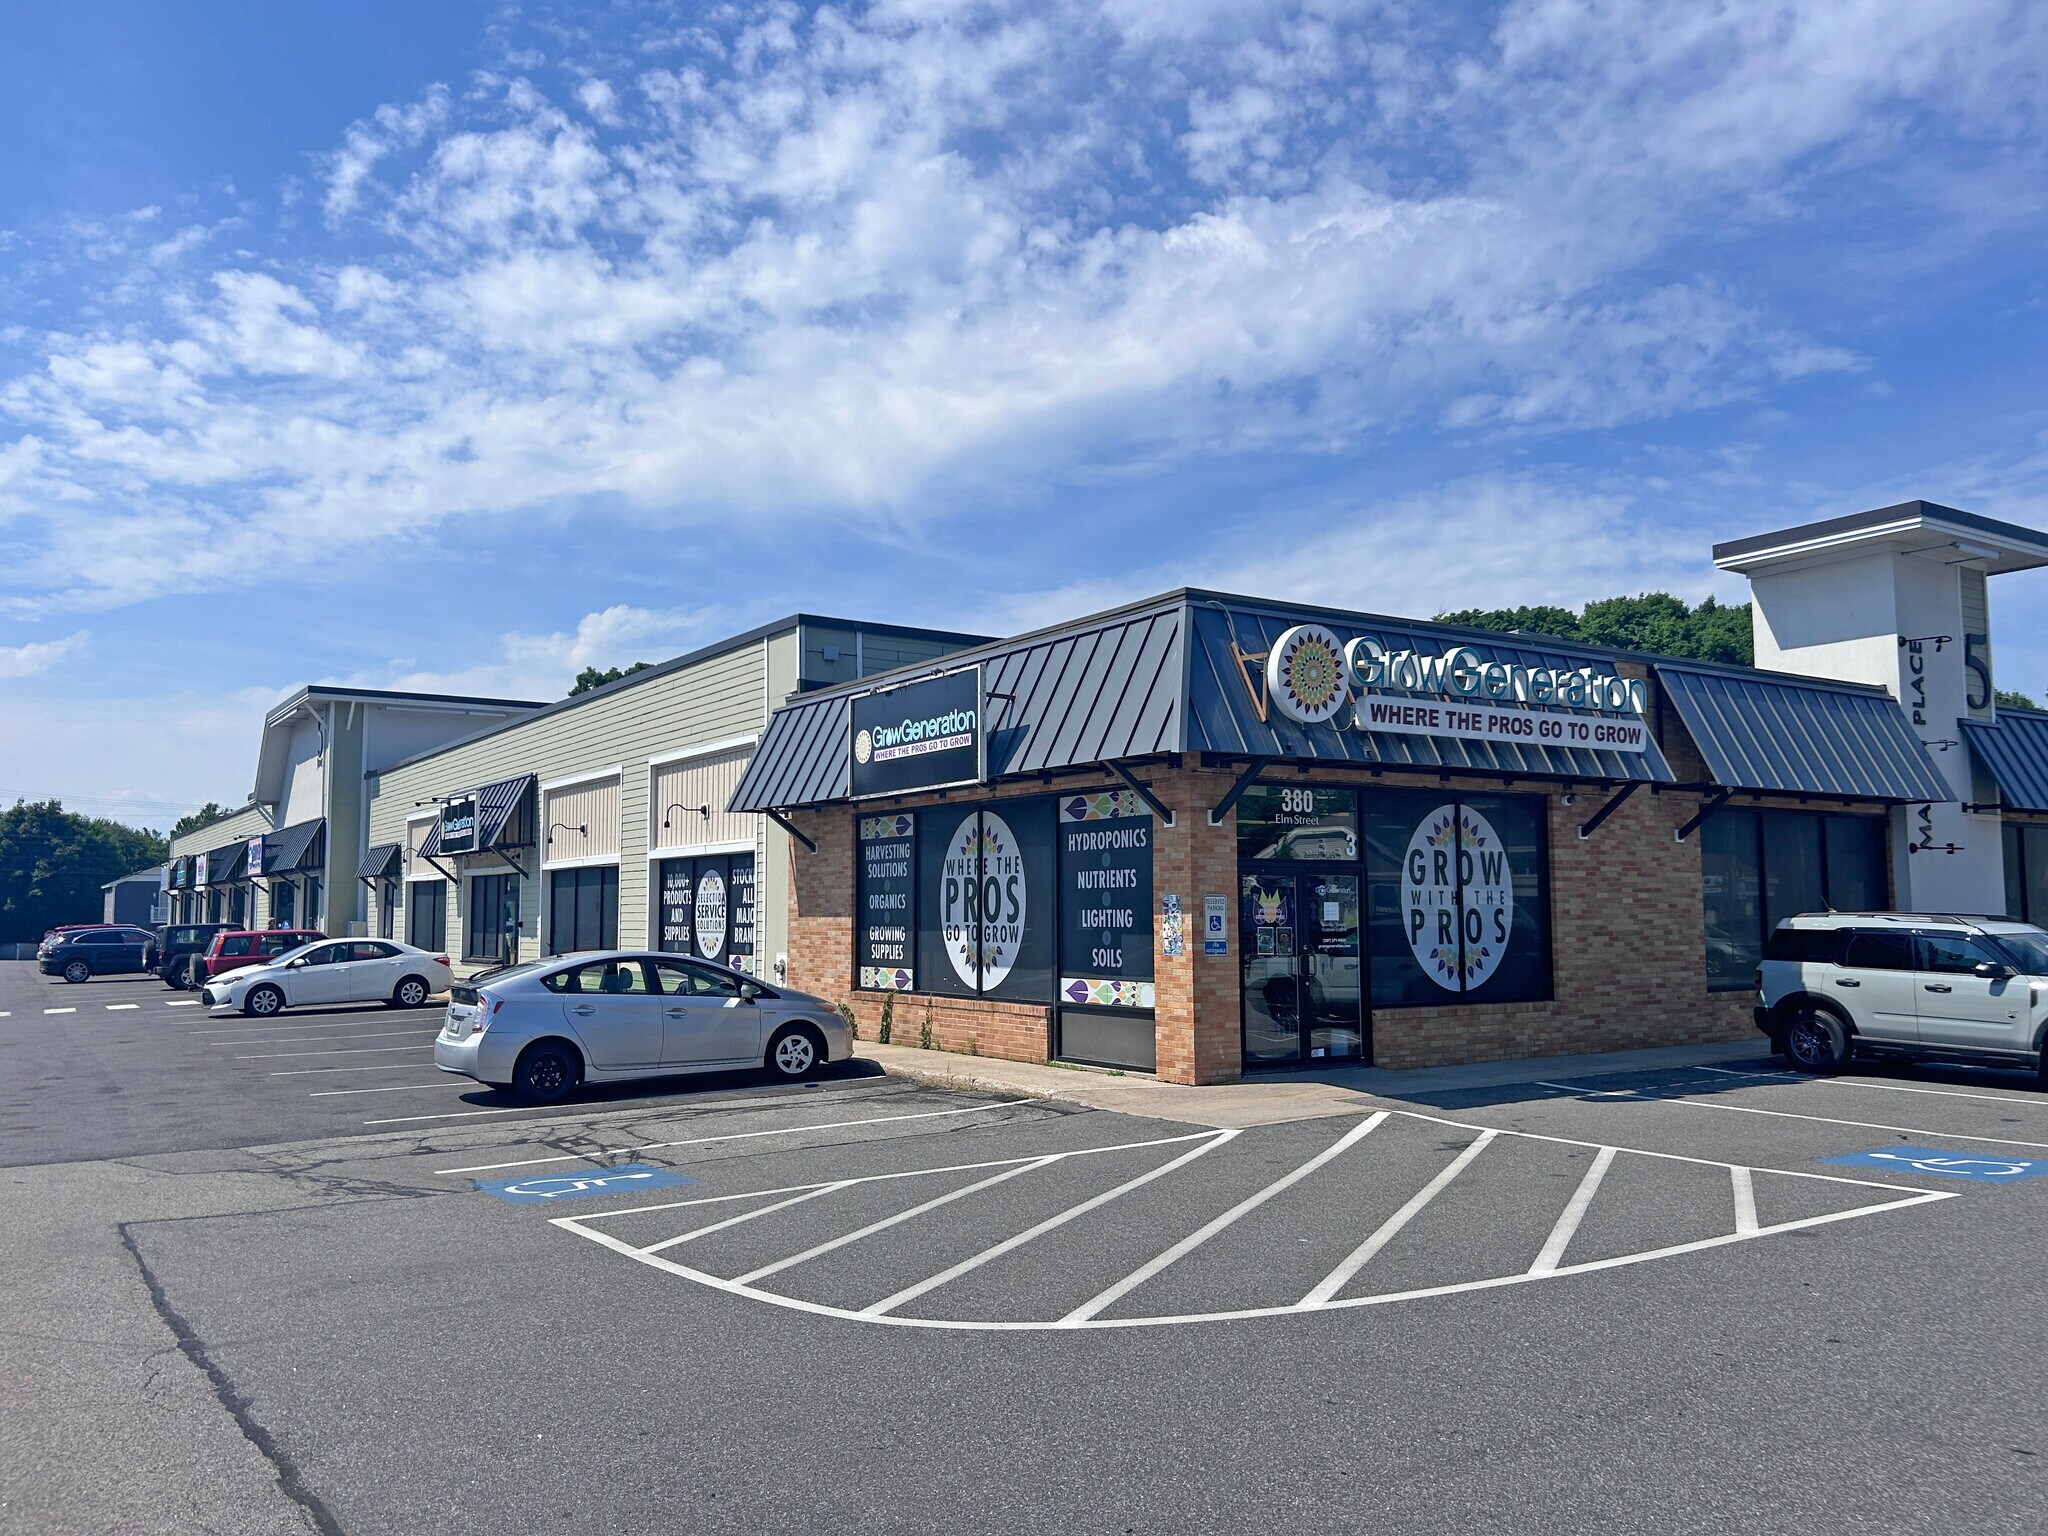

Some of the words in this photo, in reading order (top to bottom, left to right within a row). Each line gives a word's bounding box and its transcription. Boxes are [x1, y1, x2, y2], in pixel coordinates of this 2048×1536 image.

[1346, 636, 1647, 713] GrowGeneration
[1965, 633, 1991, 709] 5
[1909, 640, 1927, 726] PLACE
[872, 708, 976, 748] GrowGeneration
[1370, 704, 1439, 728] WHERE
[1446, 711, 1482, 731] THE
[1487, 715, 1533, 736] PROS
[1539, 719, 1563, 739] GO
[1568, 722, 1590, 741] TO
[1594, 724, 1641, 745] GROW
[875, 749, 896, 760] WHERE
[897, 746, 910, 756] THE
[911, 744, 927, 754] PROS
[928, 741, 938, 751] GO
[939, 739, 948, 749] TO
[949, 735, 971, 746] GROW
[1281, 789, 1313, 813] 380
[1275, 813, 1293, 824] Elm
[1294, 814, 1319, 826] Street
[1068, 828, 1147, 852] HYDROPONICS
[1346, 833, 1357, 856] 3
[865, 843, 911, 861] HARVESTING
[868, 861, 908, 878] SOLUTIONS
[946, 856, 988, 876] WHERE
[996, 856, 1020, 875] THE
[1408, 848, 1503, 886] GROW
[1077, 869, 1137, 889] NUTRIENTS
[663, 889, 692, 905] PRODUCTS
[742, 887, 754, 904] ALL
[869, 893, 906, 910] ORGANICS
[945, 875, 1019, 923] PROS
[1411, 890, 1458, 906] WITH
[1474, 890, 1505, 905] THE
[671, 908, 684, 923] AND
[697, 904, 725, 919] SERVICE
[736, 907, 754, 923] MAJO
[1081, 909, 1133, 928] LIGHTING
[664, 925, 690, 941] SUPPLIES
[697, 920, 725, 930] SOLUTIONS
[869, 926, 906, 942] GROWING
[946, 926, 960, 943] GO
[965, 926, 979, 943] TO
[983, 925, 1019, 943] GROW
[1410, 907, 1507, 945] PROS
[734, 927, 754, 944] BRAN
[871, 943, 904, 960] SUPPLIES
[1092, 948, 1123, 968] SOILS
